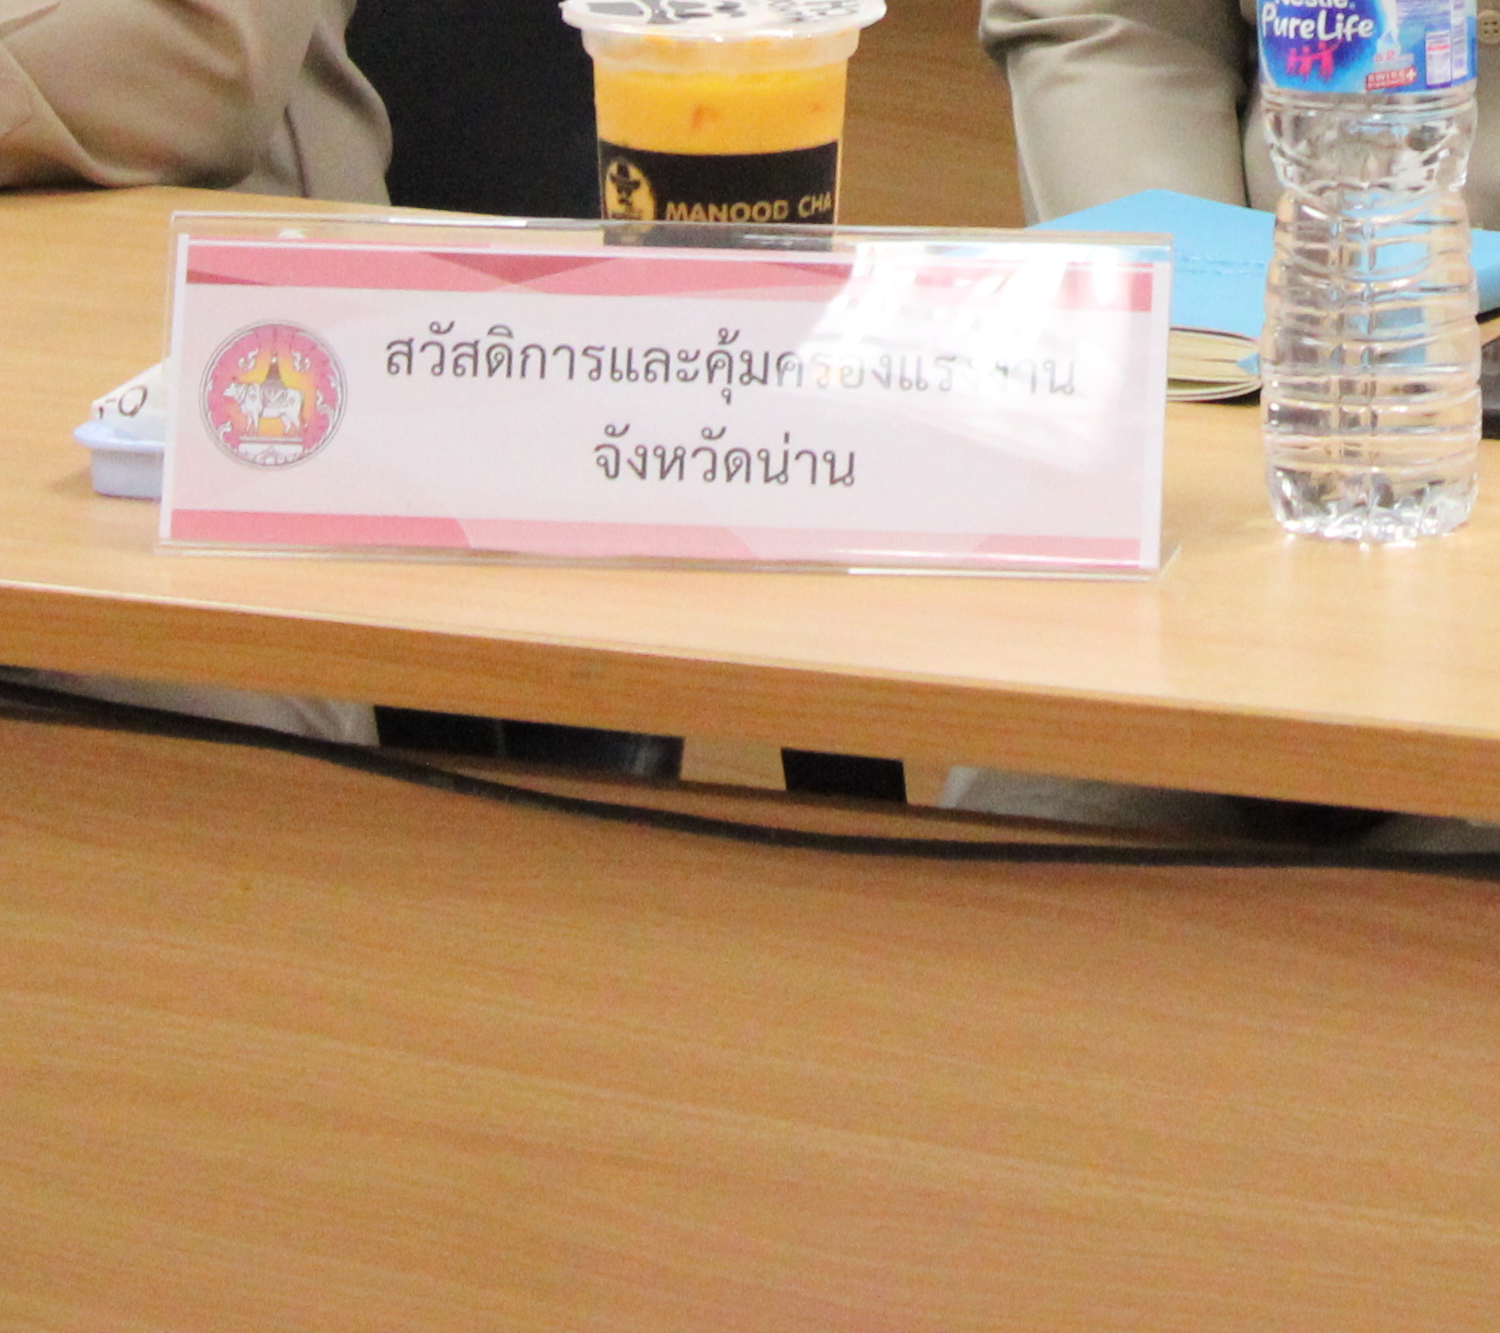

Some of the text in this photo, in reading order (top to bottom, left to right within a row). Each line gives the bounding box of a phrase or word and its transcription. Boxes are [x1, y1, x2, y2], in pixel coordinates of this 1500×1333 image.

[665, 199, 790, 223] MANOOD
[384, 321, 1077, 407] สวัสดิการและคุ้มครองแรงาน
[594, 425, 857, 491] จังหวัดน่าน
